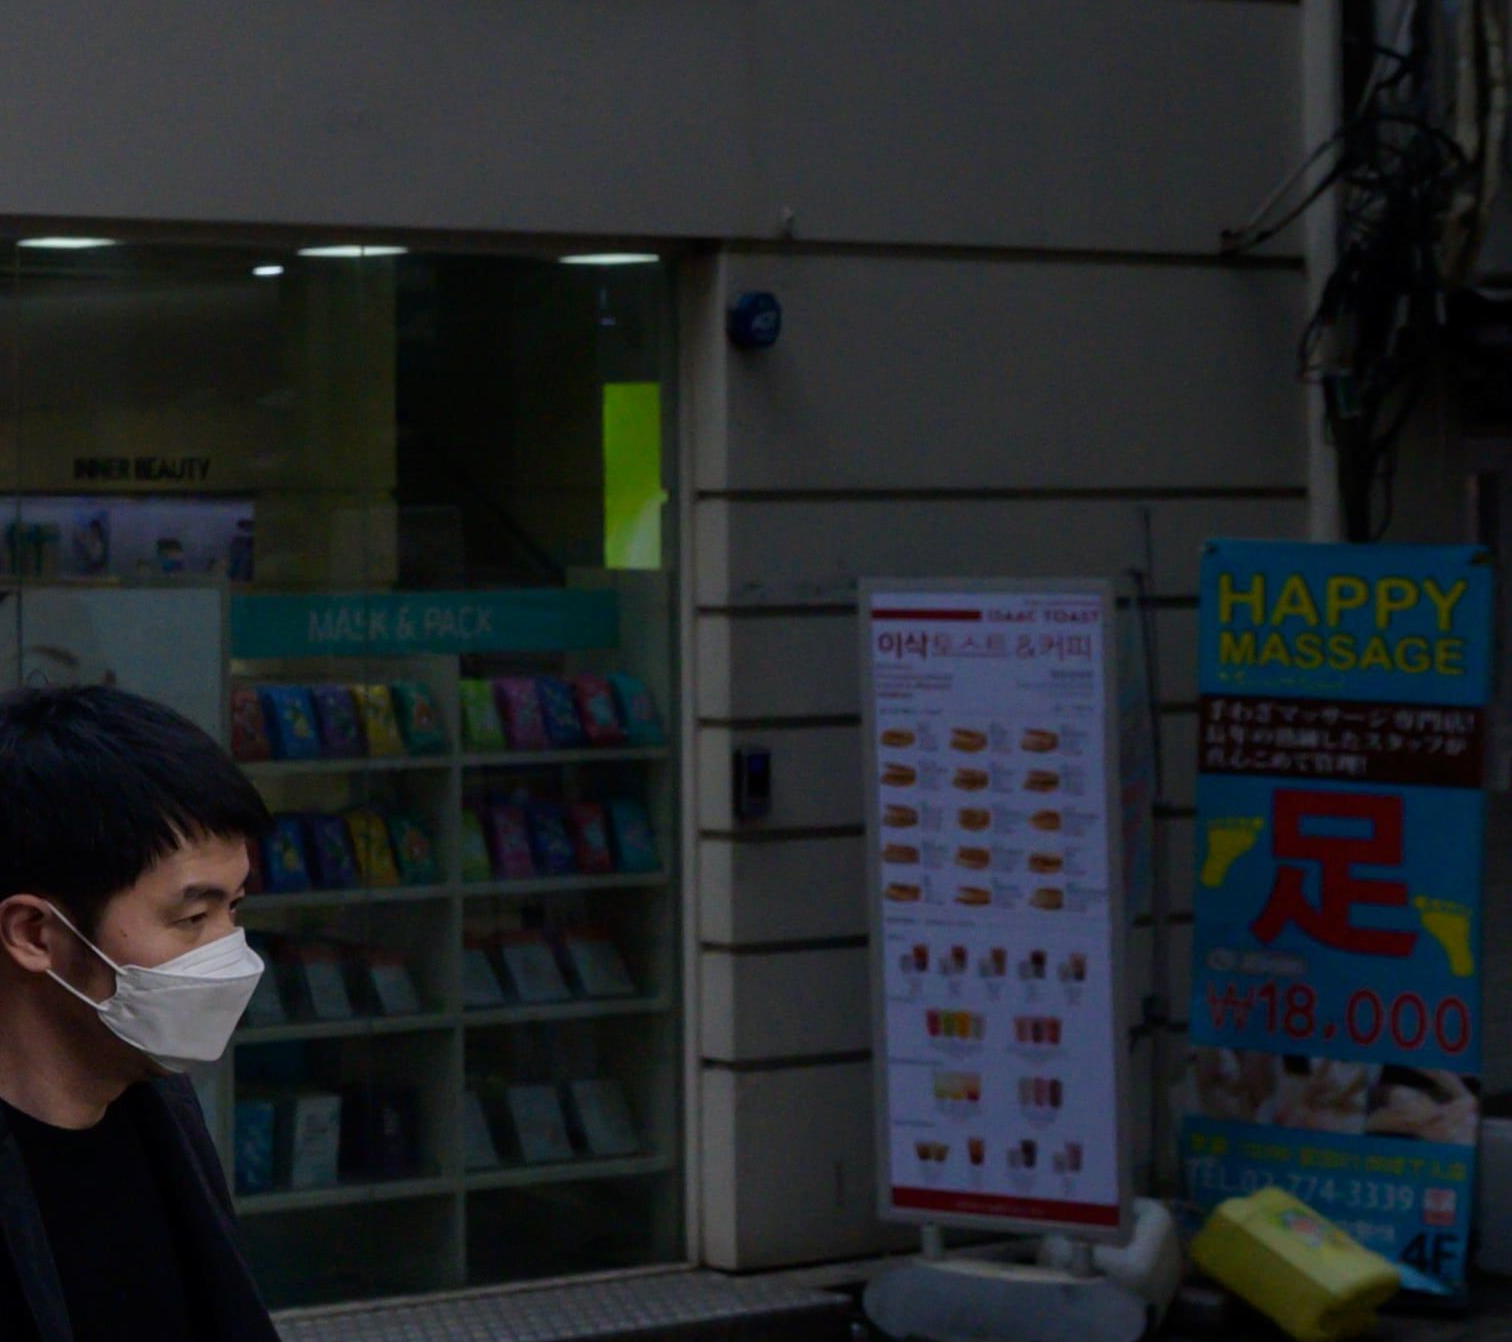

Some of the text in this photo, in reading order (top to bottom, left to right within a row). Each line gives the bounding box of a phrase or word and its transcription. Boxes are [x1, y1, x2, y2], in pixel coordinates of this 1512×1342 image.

[134, 457, 211, 482] BEAUTY
[307, 605, 495, 644] MASK & PACK
[1217, 572, 1468, 632] HAPPY
[1217, 630, 1465, 676] MASSAGE
[1250, 788, 1419, 958] 足
[1205, 977, 1472, 1056] ₩18,000
